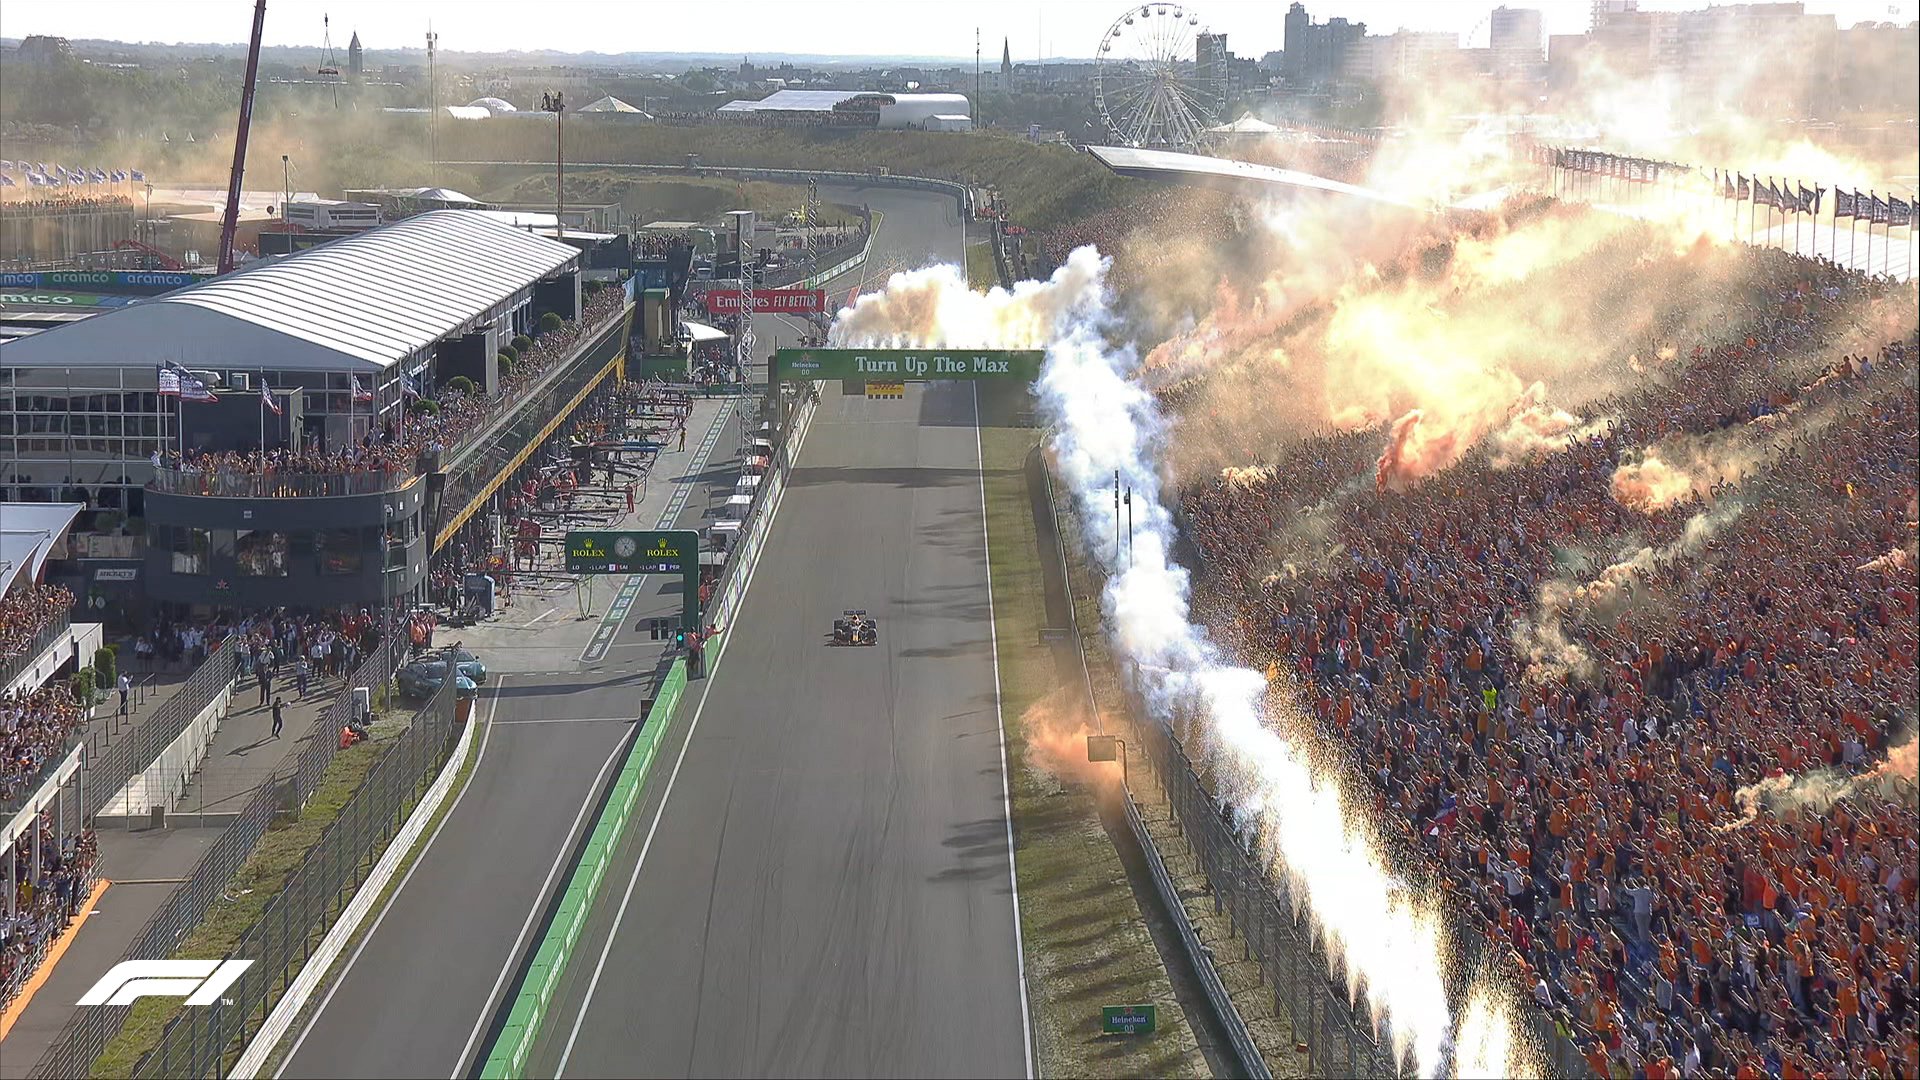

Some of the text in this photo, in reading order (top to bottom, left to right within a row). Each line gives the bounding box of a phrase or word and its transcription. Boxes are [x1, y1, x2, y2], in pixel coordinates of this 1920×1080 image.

[52, 272, 109, 283] aramco
[127, 274, 182, 285] aramco
[716, 296, 769, 307] Emites
[773, 295, 787, 307] FLY
[854, 356, 1009, 376] Turn Up The Max
[572, 549, 605, 557] ROLEX
[647, 549, 679, 557] ROLEX
[1111, 1015, 1146, 1024] Heineken
